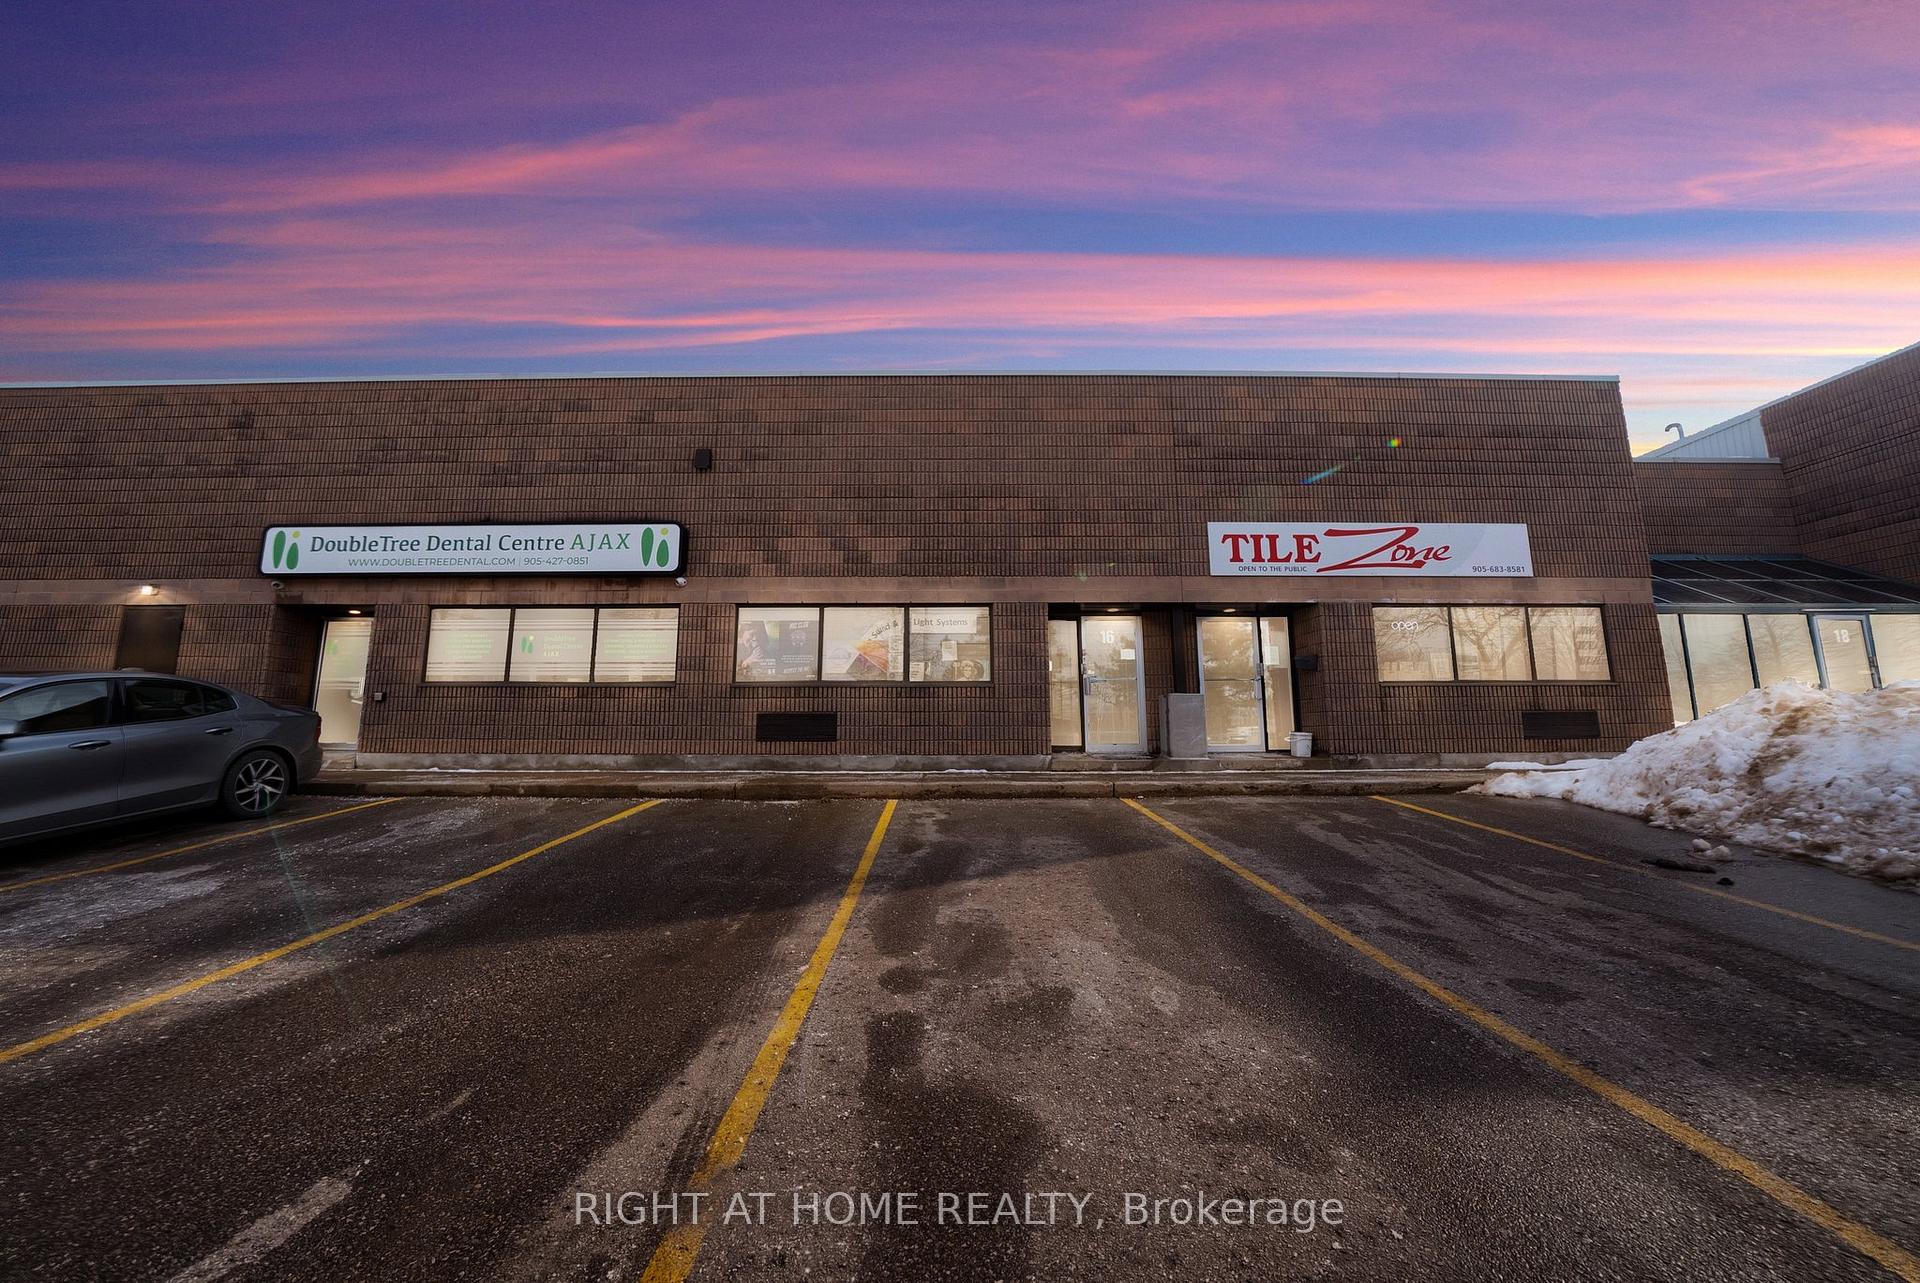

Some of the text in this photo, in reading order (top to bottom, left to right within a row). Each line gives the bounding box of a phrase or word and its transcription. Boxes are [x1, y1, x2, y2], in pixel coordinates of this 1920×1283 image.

[310, 533, 631, 553] DoubleTree Dental Centre AJAX
[1221, 526, 1453, 573] TILE Zone
[348, 556, 589, 566] WWW.DOUBLETREEDENTAL.COM 905-427-0851
[1284, 565, 1308, 573] PUBLIC
[1472, 565, 1526, 573] 905-683-8581
[936, 618, 968, 627] Systems
[1099, 630, 1114, 643] 16
[1833, 629, 1850, 643] 18
